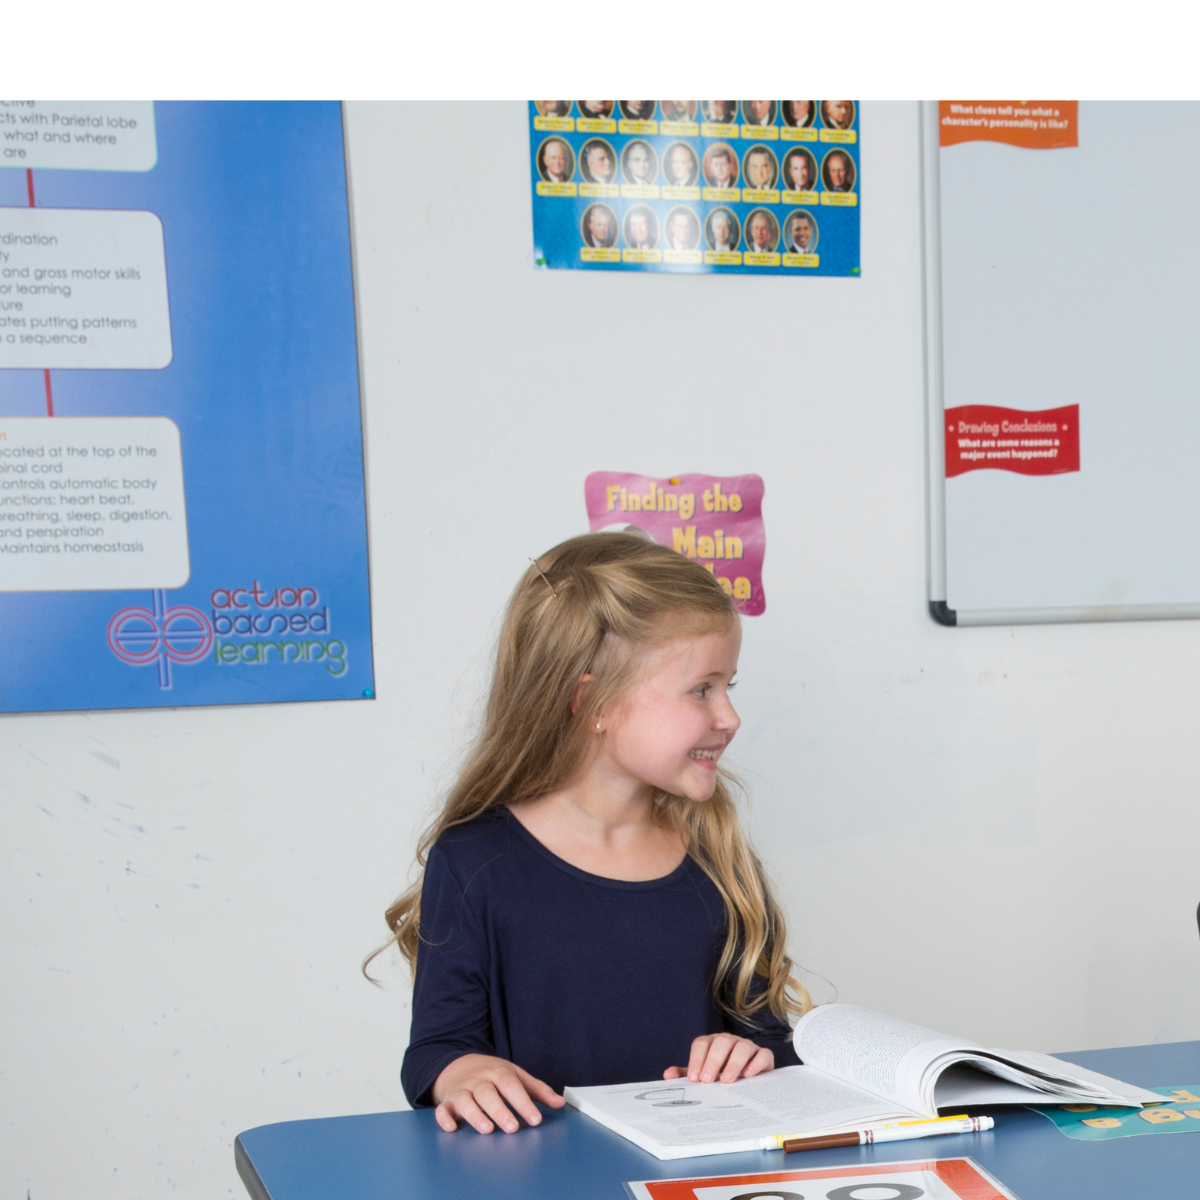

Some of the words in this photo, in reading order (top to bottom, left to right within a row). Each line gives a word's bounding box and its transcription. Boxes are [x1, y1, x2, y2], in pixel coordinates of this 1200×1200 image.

[950, 104, 973, 115] What
[974, 105, 997, 115] clues
[998, 106, 1013, 115] tell
[1014, 108, 1030, 118] you
[1031, 107, 1053, 117] what
[19, 112, 49, 125] with
[52, 113, 103, 127] Parietal
[107, 116, 138, 129] lobe
[942, 116, 988, 127] character's
[989, 118, 1038, 131] personality
[1039, 119, 1047, 129] is
[1048, 119, 1068, 129] like?
[4, 130, 39, 142] what
[43, 131, 71, 143] and
[75, 132, 117, 145] where
[3, 148, 27, 159] are
[2, 267, 30, 279] and
[33, 268, 67, 281] gross
[71, 267, 111, 280] motor
[115, 267, 141, 280] skills
[16, 282, 72, 298] learning
[30, 316, 79, 330] putting
[82, 316, 138, 330] patterns
[6, 334, 16, 344] a
[19, 334, 88, 347] sequence
[958, 420, 1000, 438] Drawing
[1001, 418, 1058, 433] Conclusions
[958, 438, 980, 448] What
[981, 439, 996, 448] are
[997, 439, 1019, 448] some
[1020, 438, 1053, 447] reasons
[48, 446, 63, 458] at
[66, 445, 89, 458] the
[92, 446, 116, 459] top
[118, 445, 132, 457] of
[135, 445, 158, 457] the
[960, 450, 985, 461] major
[987, 449, 1011, 459] event
[1011, 448, 1058, 460] happened?
[31, 461, 63, 474] cord
[49, 477, 119, 490] automatic
[122, 476, 158, 491] body
[59, 493, 95, 506] heart
[99, 493, 136, 507] beat,
[606, 482, 695, 520] Finding
[702, 483, 743, 513] the
[66, 509, 106, 523] sleep,
[109, 509, 173, 524] digestion,
[26, 525, 105, 539] perspiration
[64, 540, 145, 553] homeostasis
[672, 525, 743, 559] Main
[211, 579, 318, 608] action
[212, 606, 328, 635] based
[214, 637, 346, 675] learning
[1081, 1116, 1123, 1129] a
